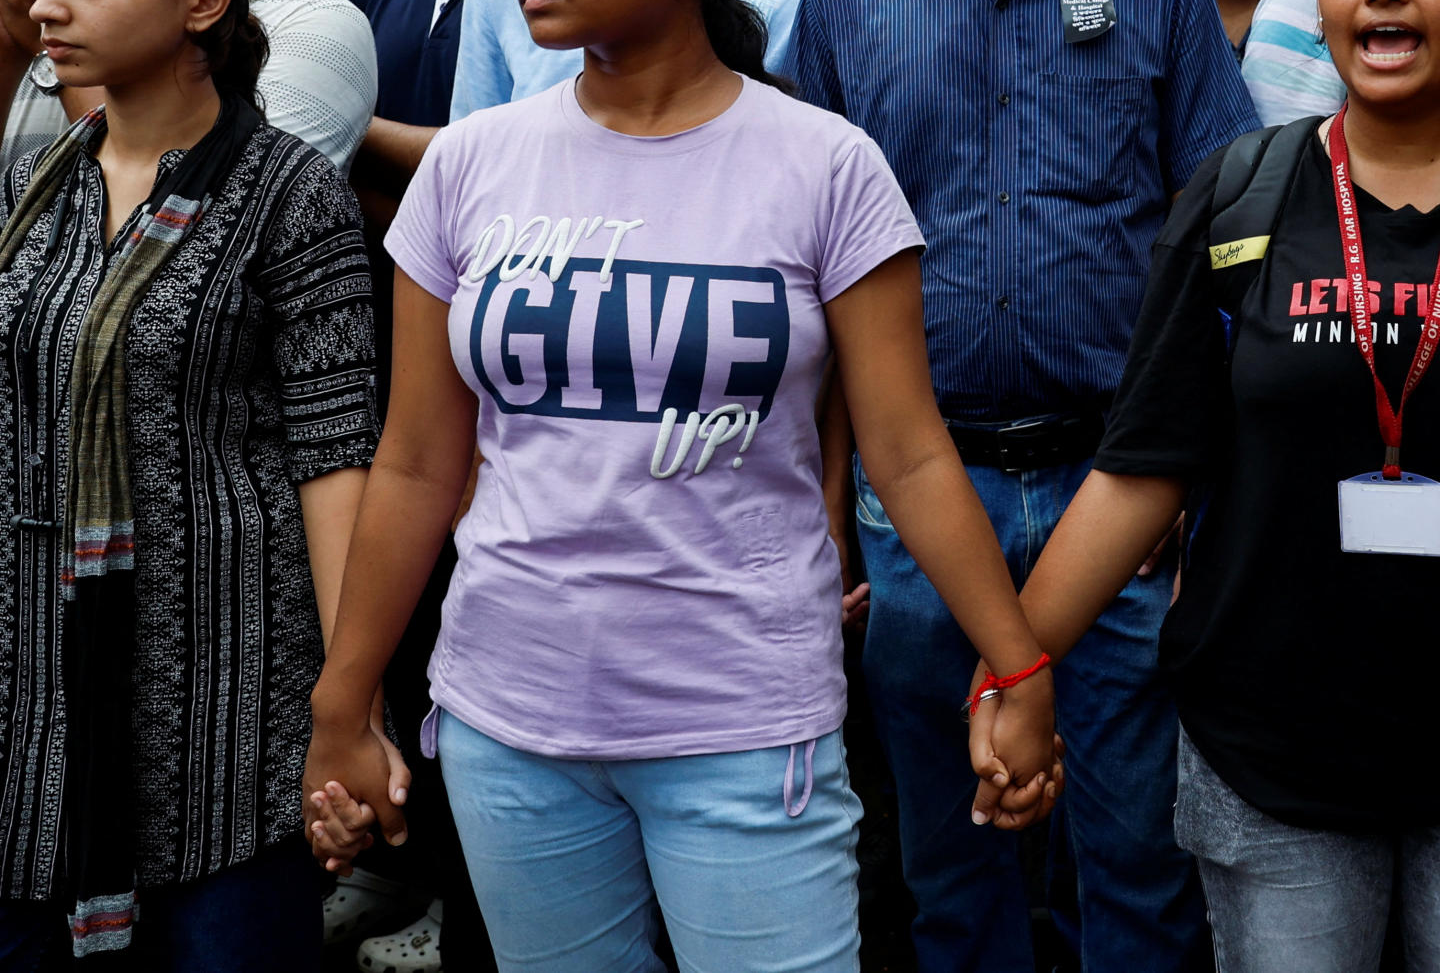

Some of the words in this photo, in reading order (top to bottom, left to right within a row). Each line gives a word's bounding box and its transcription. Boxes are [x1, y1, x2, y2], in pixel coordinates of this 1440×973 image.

[1336, 162, 1353, 215] HOSPITAL
[469, 214, 645, 283] DON'T
[1344, 217, 1357, 240] KAR
[1348, 243, 1360, 263] R.G.
[1352, 273, 1367, 329] NURSING
[480, 267, 775, 414] GIVE
[1359, 333, 1369, 352] OF
[1405, 341, 1433, 392] OLLEGE
[1428, 319, 1440, 339] OF
[650, 404, 760, 479] UP!
